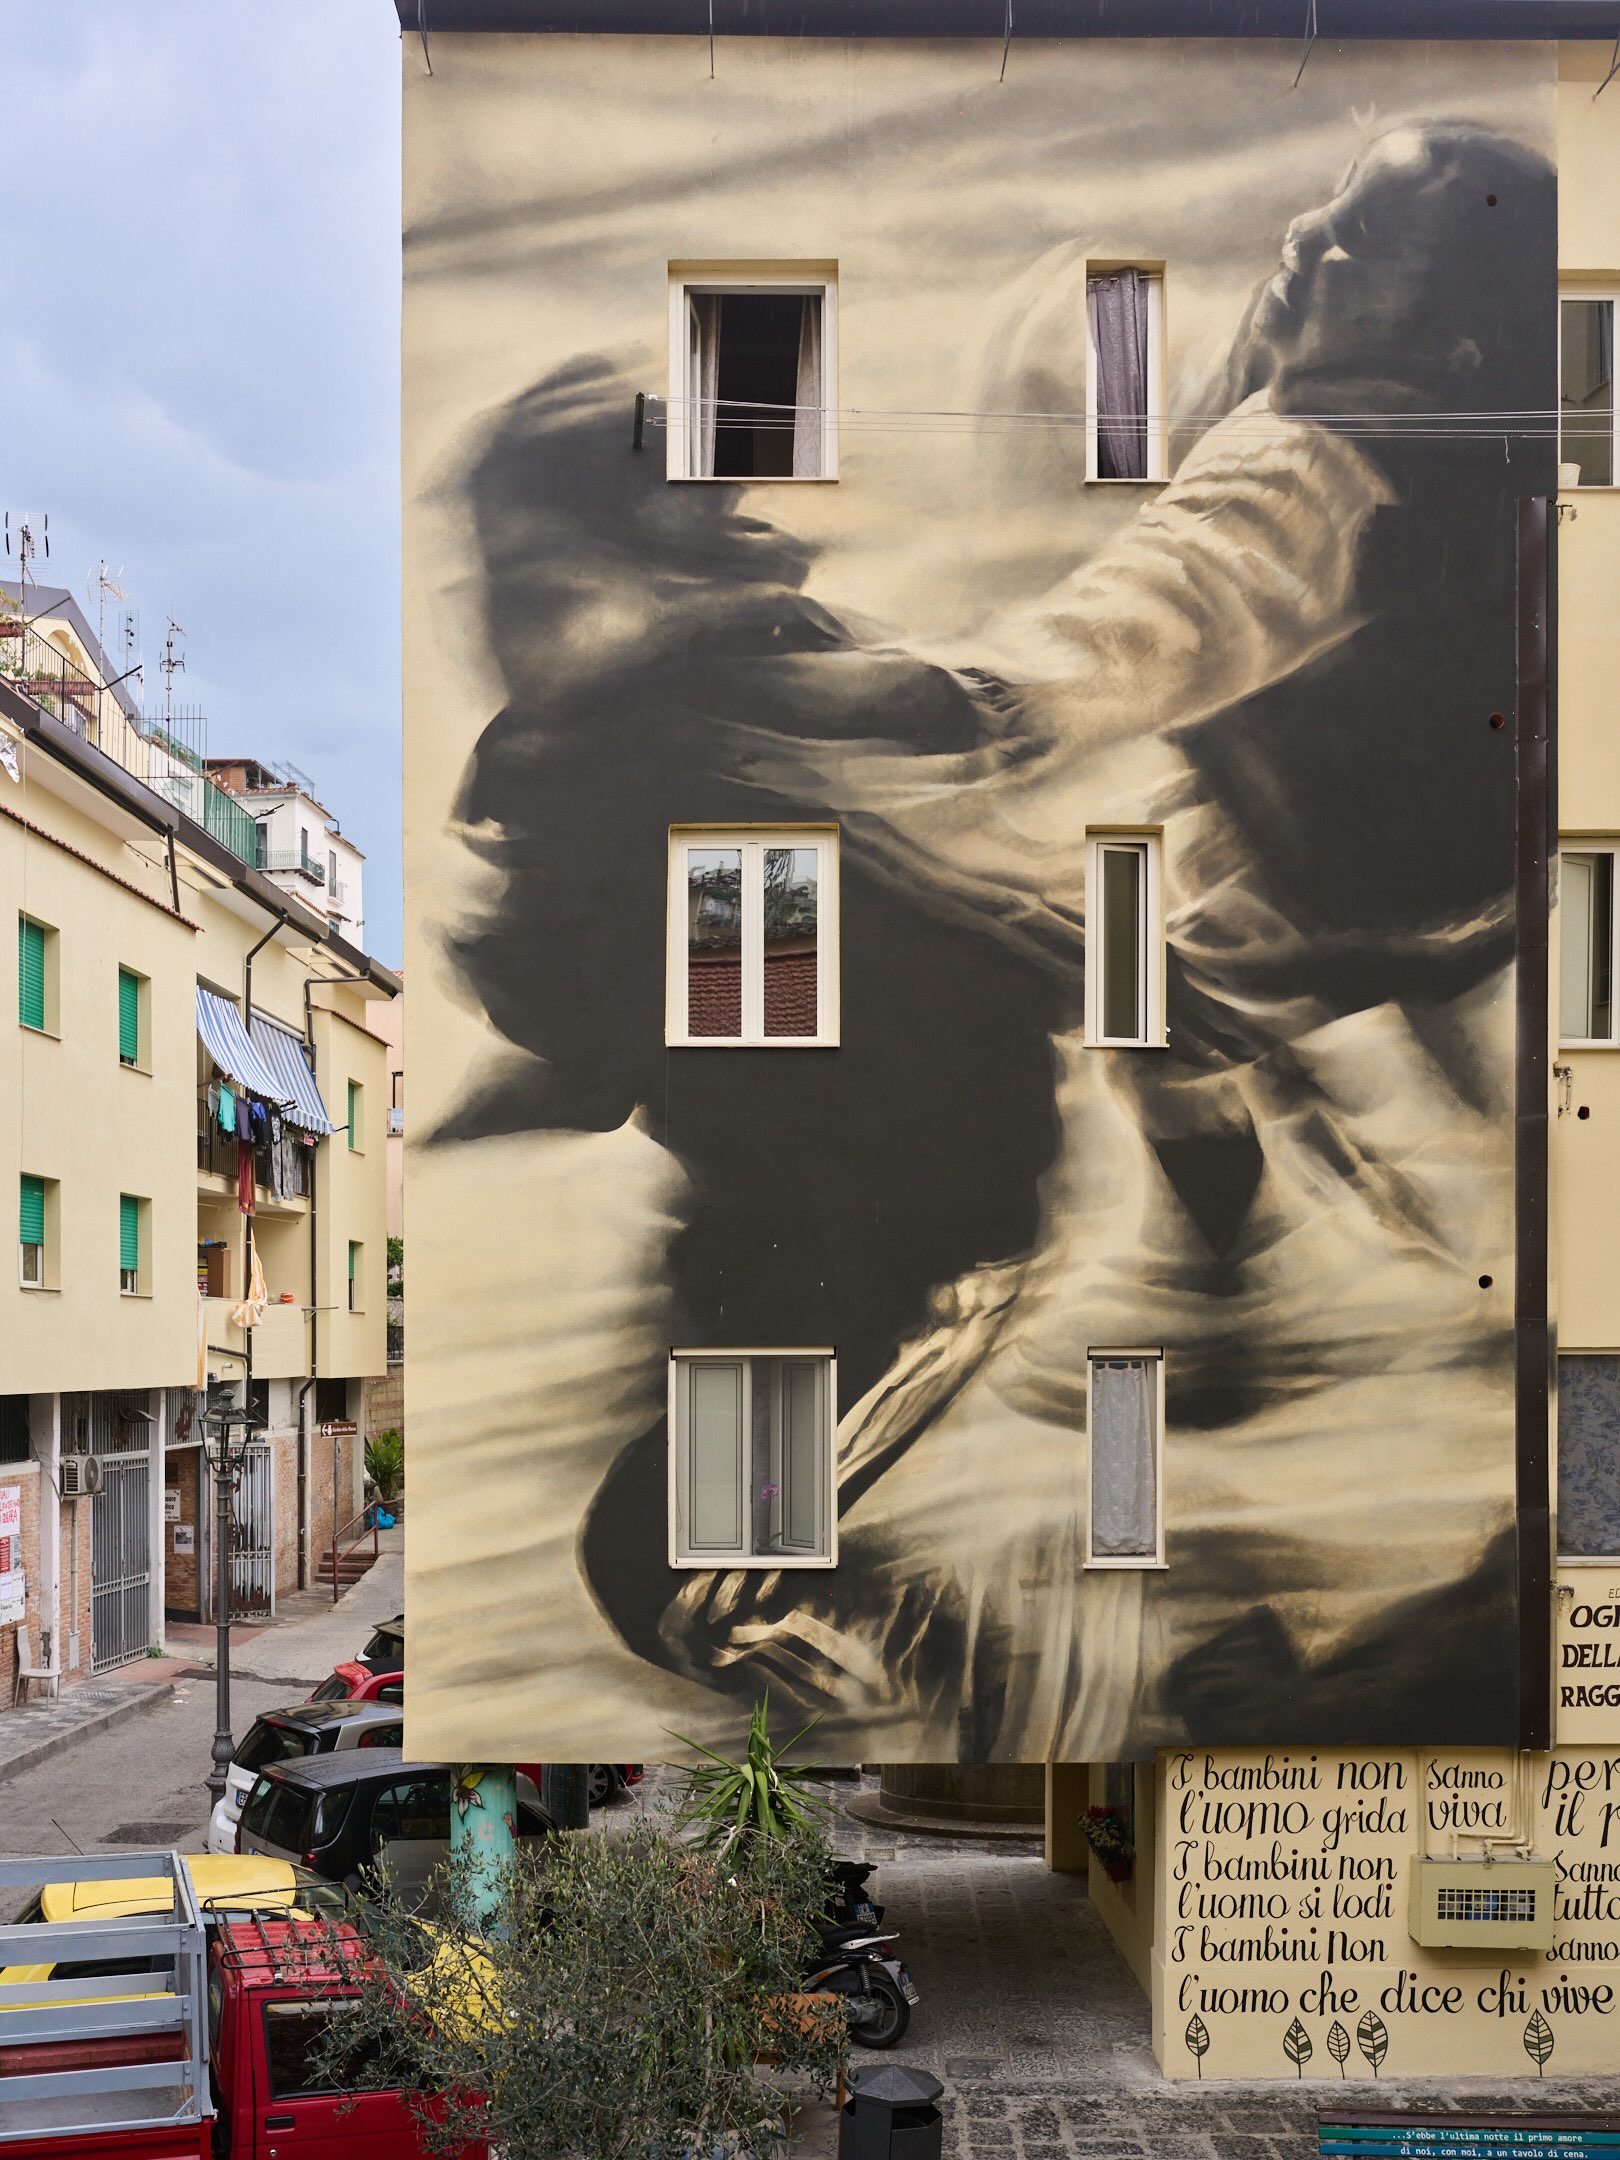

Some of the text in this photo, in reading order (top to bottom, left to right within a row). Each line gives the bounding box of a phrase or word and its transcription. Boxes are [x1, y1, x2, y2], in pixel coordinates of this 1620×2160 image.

[1562, 1644, 1620, 1668] DELL
[1203, 1754, 1323, 1791] bambini
[1336, 1761, 1408, 1790] non
[1179, 1789, 1315, 1841] l'uomo
[1322, 1797, 1409, 1850] grida
[1427, 1792, 1507, 1831] viva
[1555, 1791, 1585, 1837] il
[1204, 1840, 1333, 1881] bambini
[1338, 1855, 1398, 1881] non
[1178, 1881, 1292, 1919] l'uomo
[1298, 1886, 1325, 1919] si
[1333, 1883, 1396, 1919] lodi
[1200, 1924, 1321, 1962] bambini
[1178, 1969, 1616, 2018] l'uomo che dice chi vive
[1400, 2146, 1411, 2155] di
[1415, 2146, 1436, 2156] noi,
[1461, 2147, 1481, 2157] noi,
[1512, 2149, 1544, 2158] tavolo
[1547, 2149, 1558, 2158] di
[1563, 2150, 1588, 2158] cena.
[1440, 2131, 1480, 2140] l'ultima
[1484, 2132, 1509, 2141] notte
[1513, 2132, 1524, 2141] il
[1528, 2132, 1553, 2143] primo
